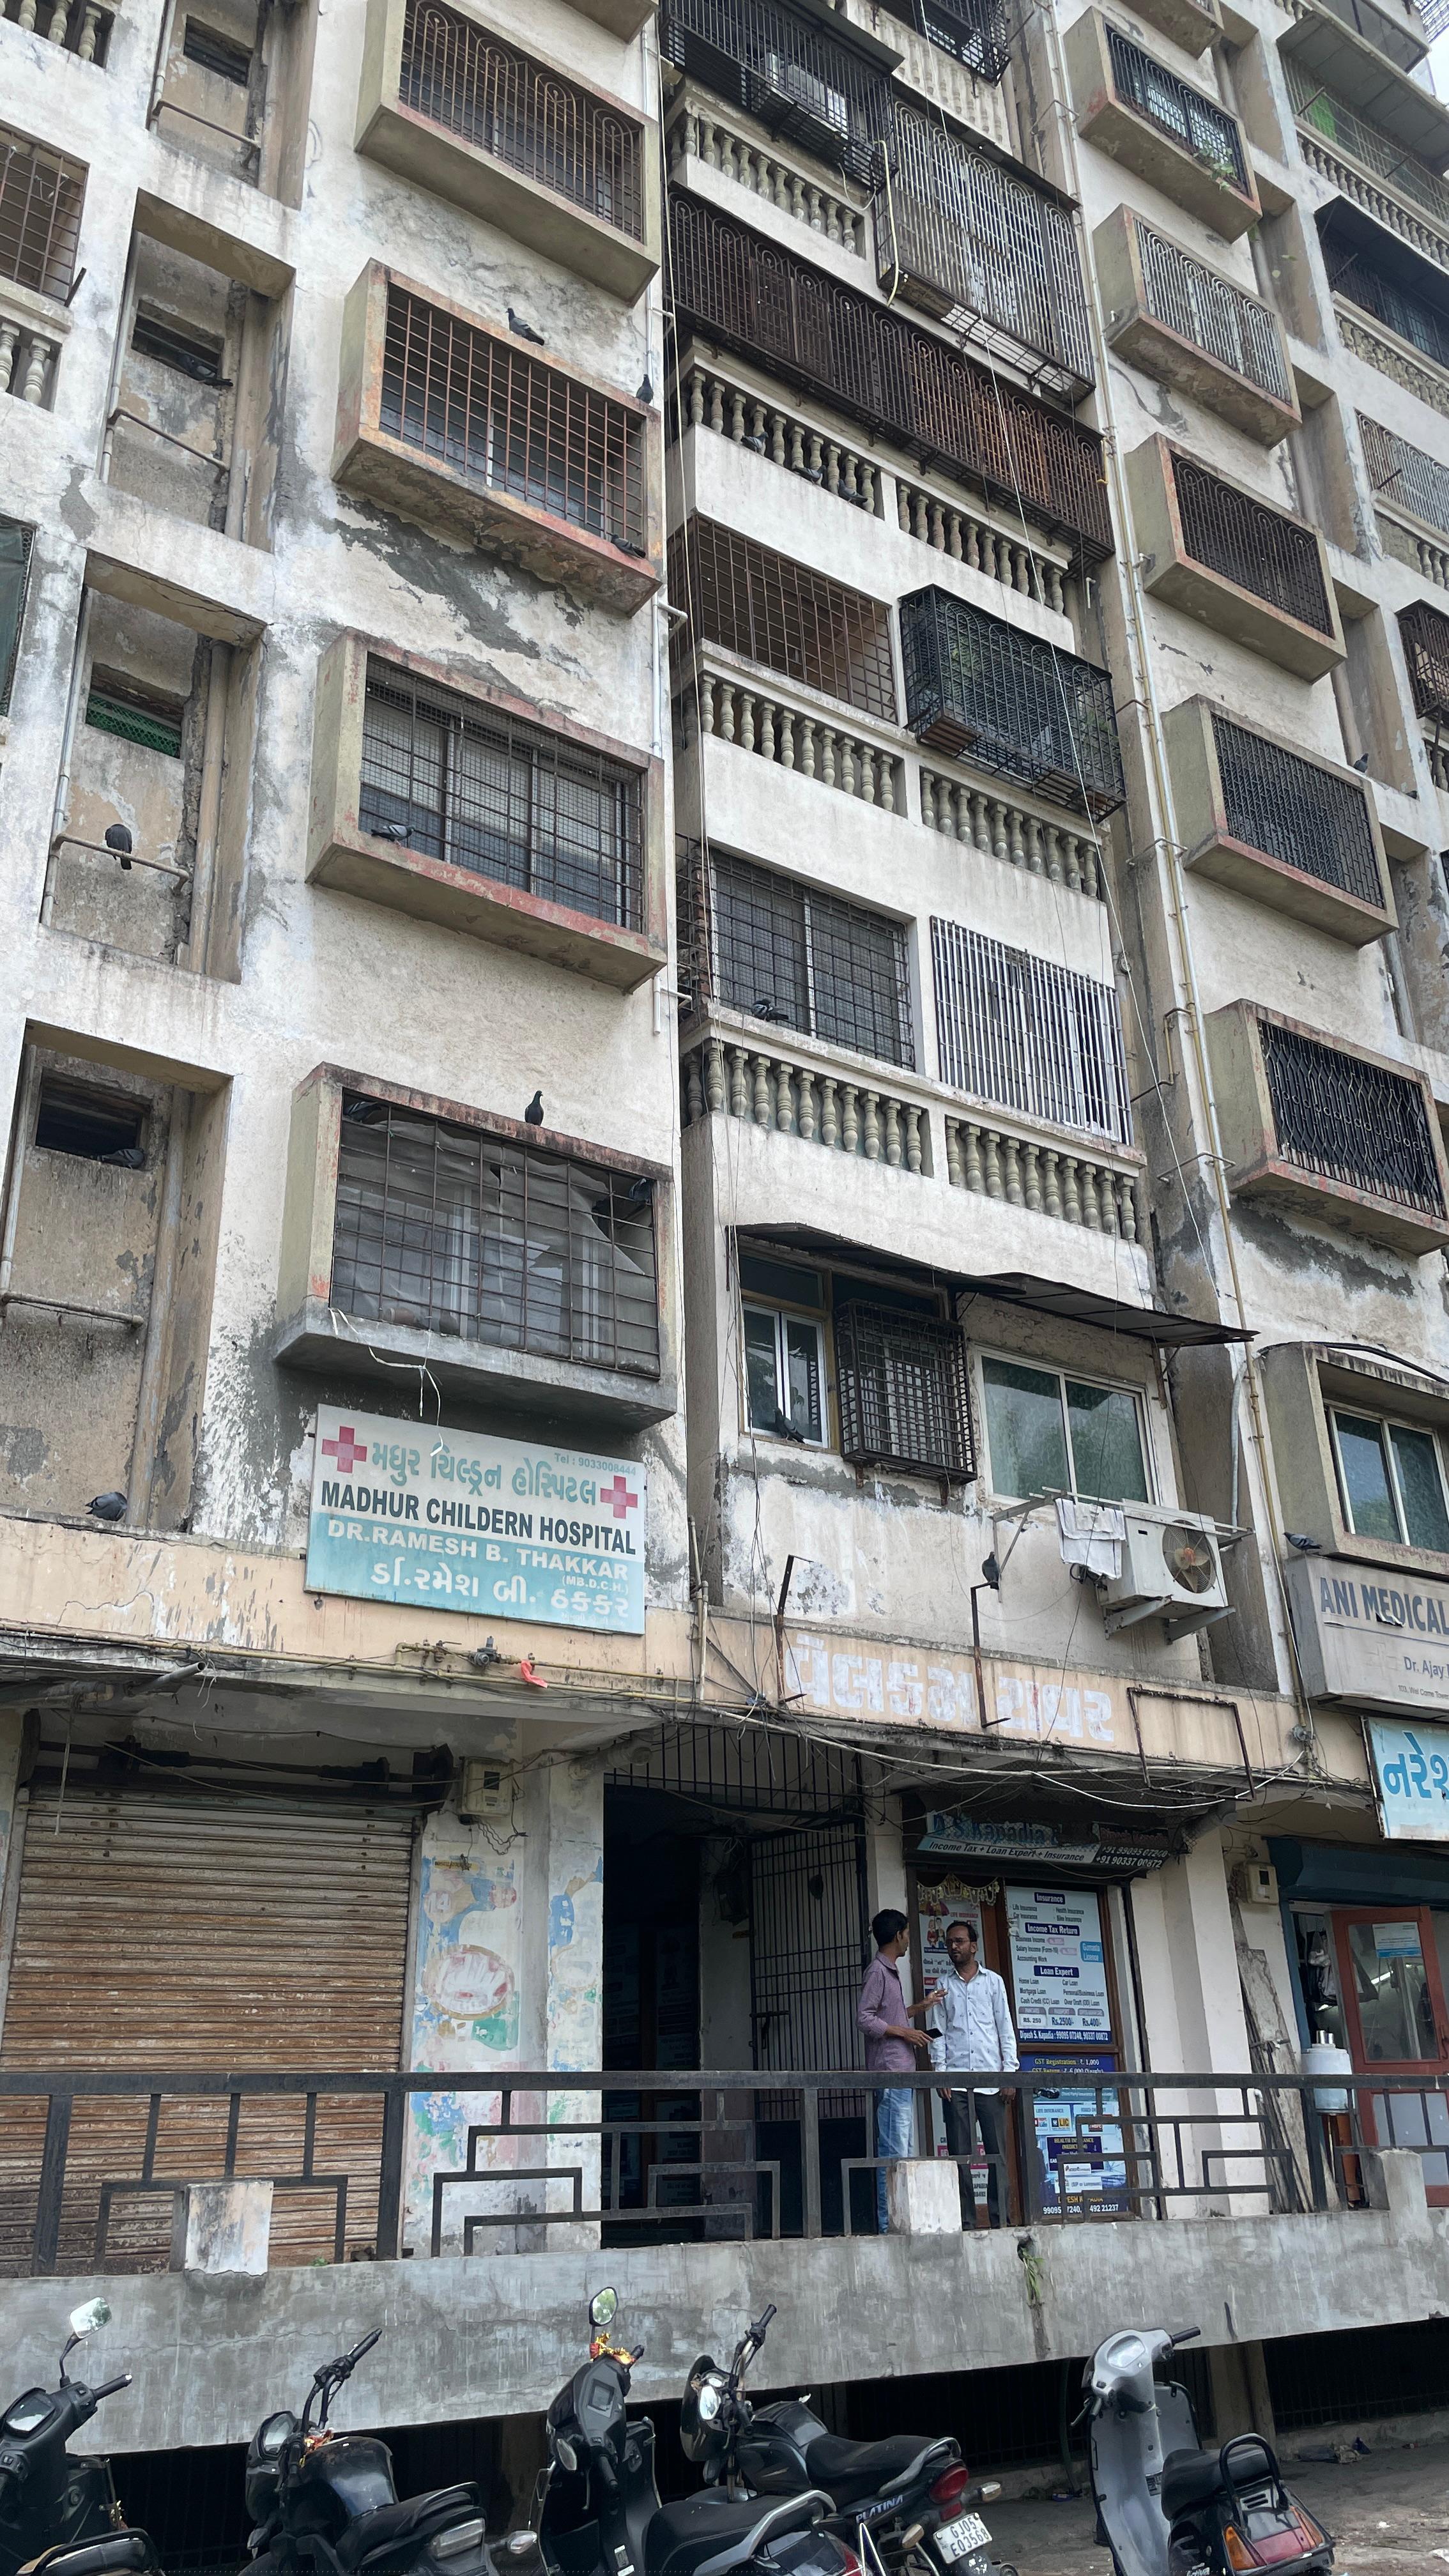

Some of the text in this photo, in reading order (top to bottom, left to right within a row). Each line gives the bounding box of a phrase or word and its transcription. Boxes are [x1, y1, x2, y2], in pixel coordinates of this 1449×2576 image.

[372, 1442, 420, 1487] મધુર
[555, 1453, 569, 1464] Tel
[578, 1457, 636, 1476] 9033008444
[321, 1480, 636, 1555] MADHUR CHILDERN HOSPITAL
[328, 1519, 628, 1581] DR.RAMESH B. THAKKAR
[562, 1574, 629, 1595] (MB.D.C.H.)
[1321, 1577, 1449, 1635] ANI MEDICAL
[1404, 1657, 1420, 1673] Dr.
[1423, 1660, 1445, 1679] Ajay
[929, 1841, 962, 1852] Income
[963, 1843, 977, 1853] Tax
[986, 1845, 1008, 1856] Loan
[1009, 1848, 1036, 1860] Expert
[1045, 1850, 1085, 1862] Insurance
[1096, 1855, 1111, 1864] +91
[1111, 1857, 1138, 1867] 90337
[1036, 1894, 1064, 1903] Insurance
[1027, 1924, 1078, 1935] Income Tax Return
[1017, 1955, 1038, 1963] Accounting
[1040, 1966, 1073, 1977] Loan Expert
[1020, 1988, 1037, 1996] Mortgage
[1020, 2030, 1033, 2041] Dipesh
[1059, 2119, 1070, 2127] LIC
[856, 2494, 903, 2523] PLATINA
[950, 2517, 977, 2538] GJ05
[950, 2527, 990, 2557] E03568
